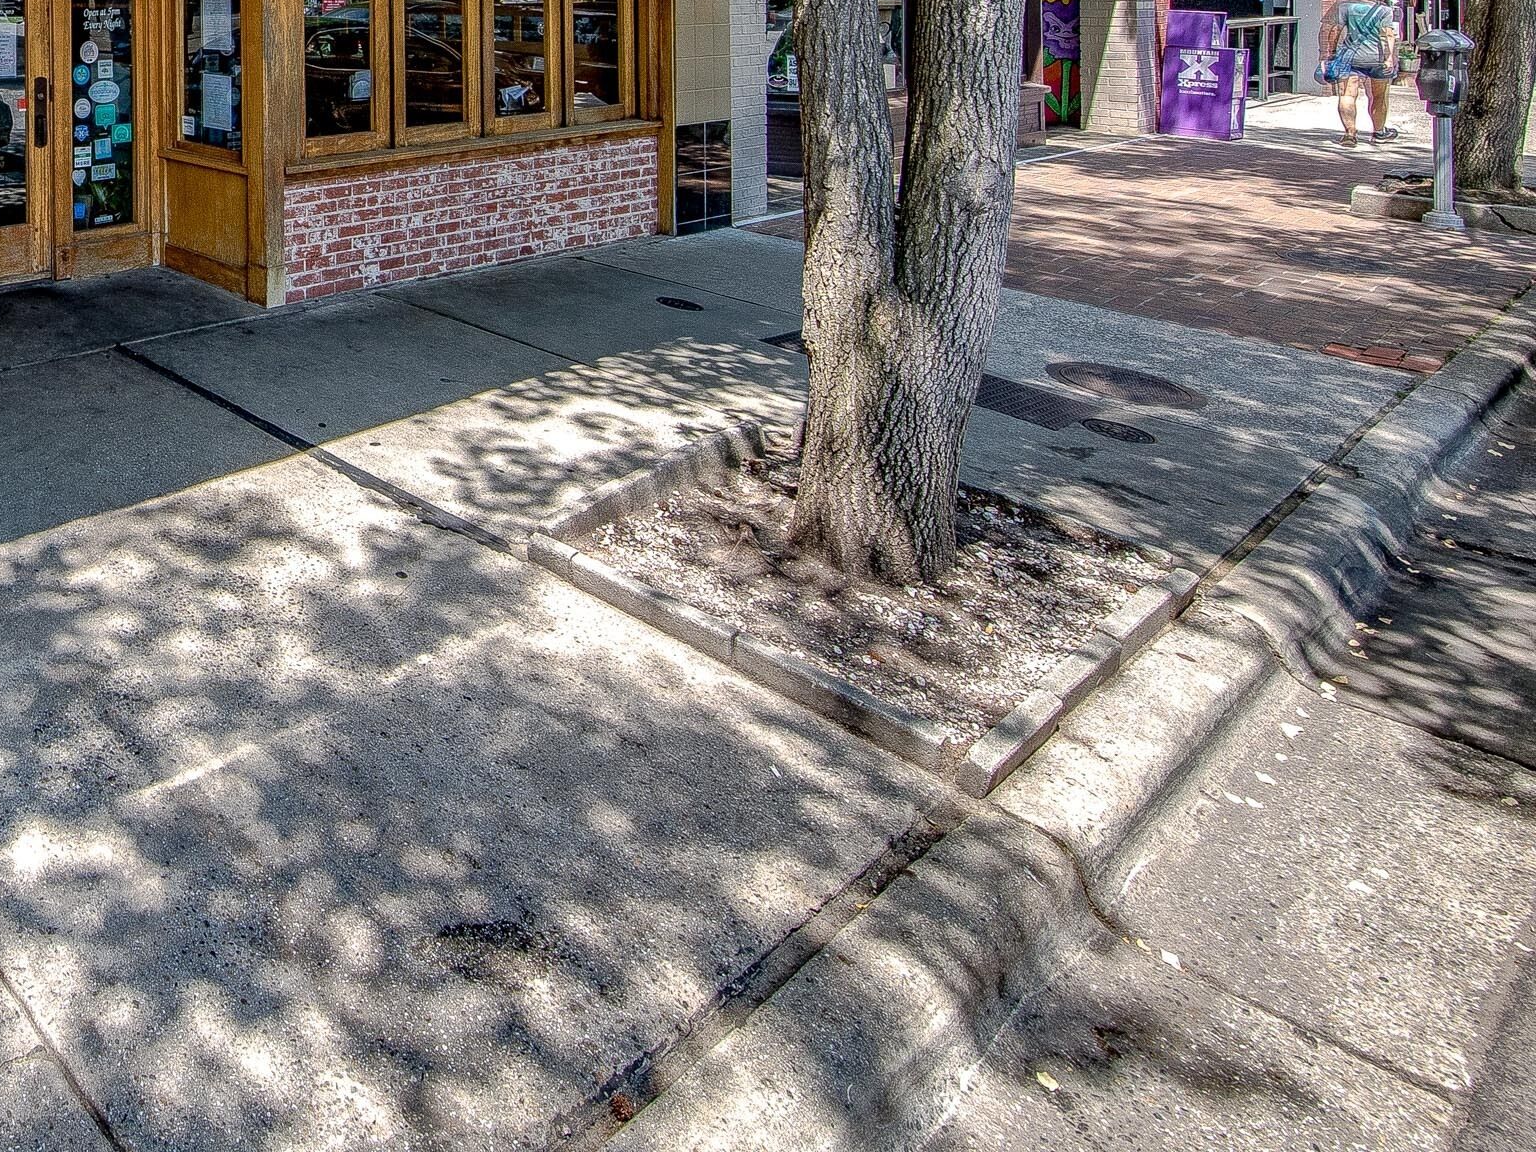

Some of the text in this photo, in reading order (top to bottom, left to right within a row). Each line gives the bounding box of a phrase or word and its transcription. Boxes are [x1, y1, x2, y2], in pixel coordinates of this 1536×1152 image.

[83, 8, 99, 20] Open
[99, 8, 107, 16] at
[83, 17, 122, 33] Every Night
[1179, 48, 1220, 56] MOUNTAIN
[1177, 54, 1220, 82] X
[1177, 78, 1219, 89] Xpress
